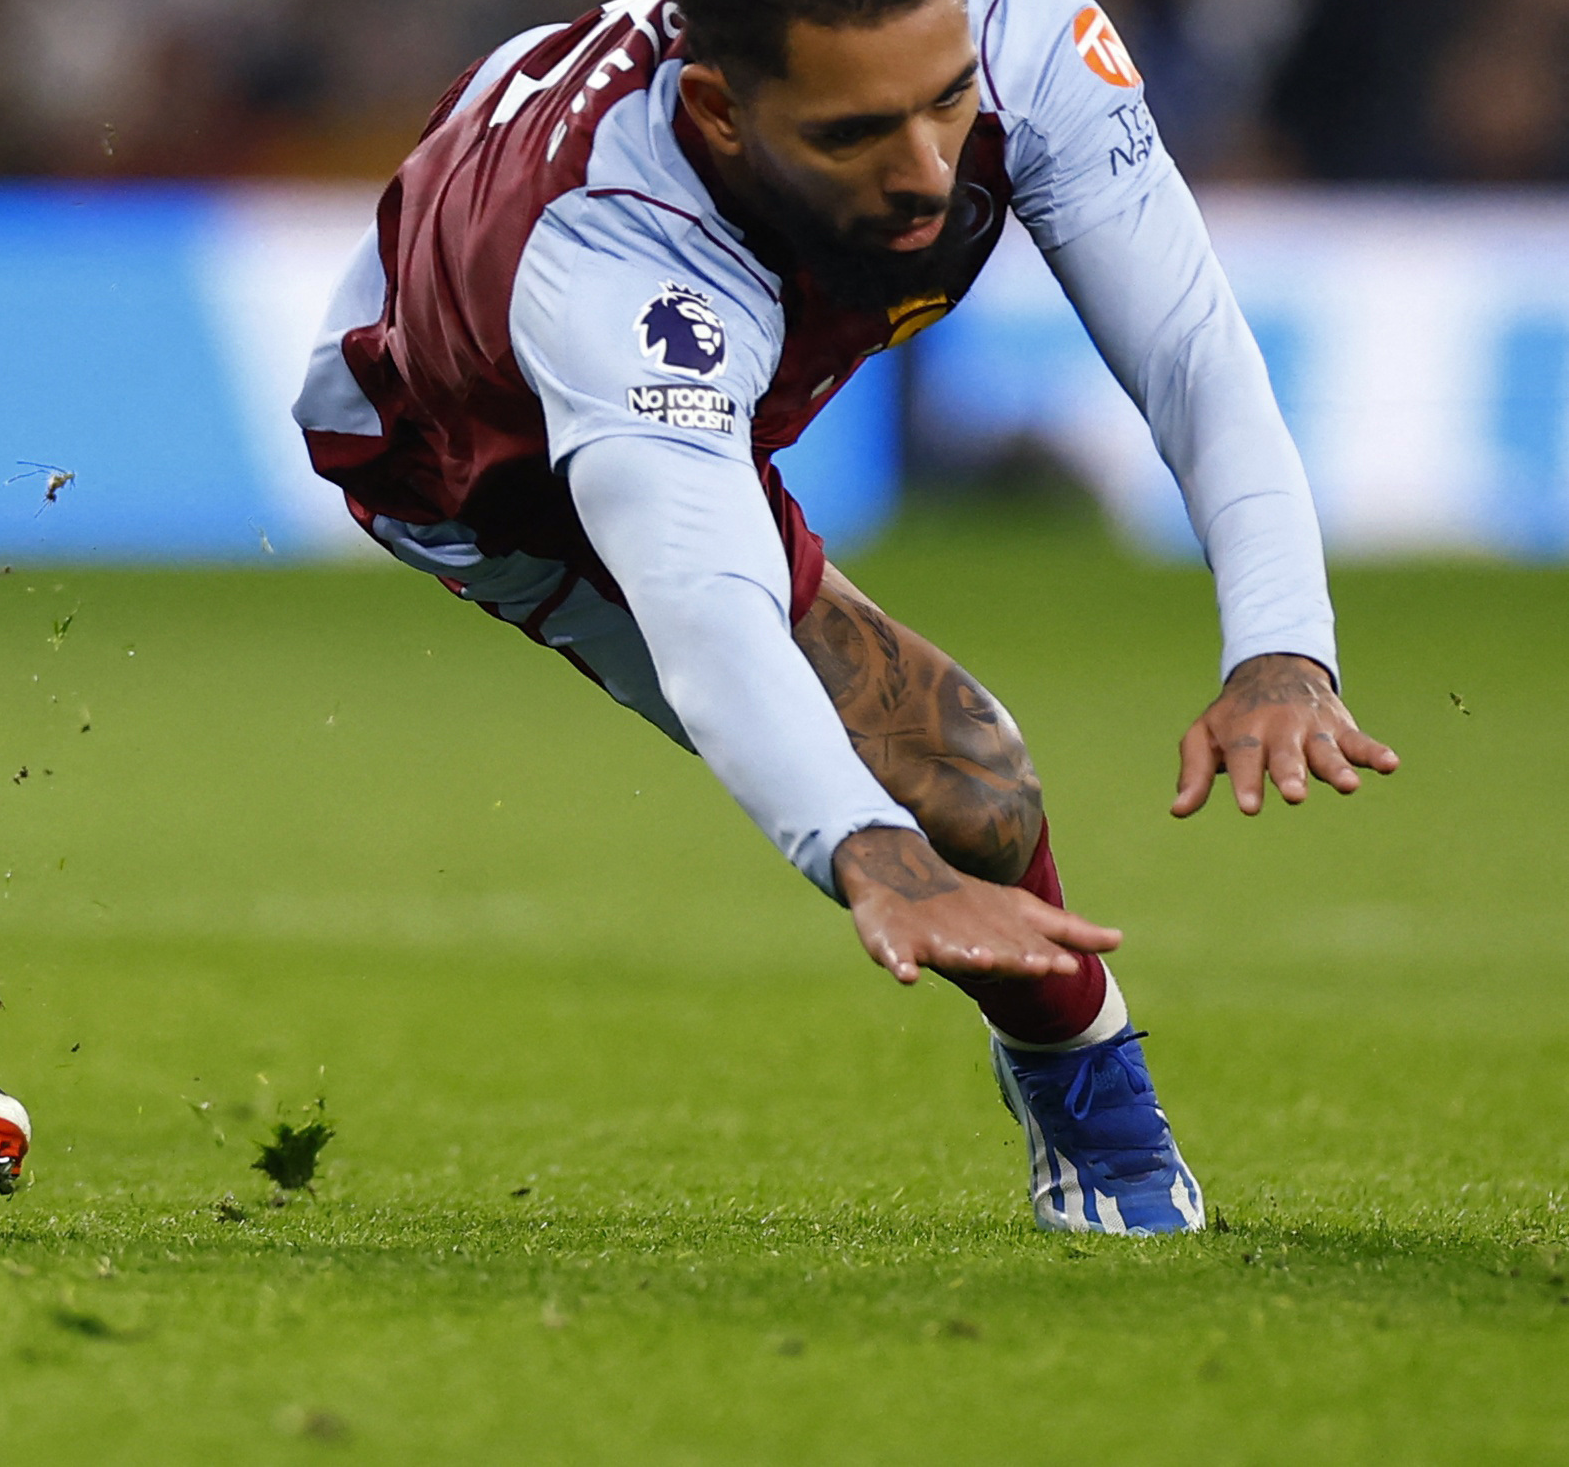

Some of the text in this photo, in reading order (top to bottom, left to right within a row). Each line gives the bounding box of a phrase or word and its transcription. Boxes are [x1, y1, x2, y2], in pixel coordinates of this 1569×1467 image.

[627, 386, 729, 414] No room
[666, 408, 735, 433] racism
